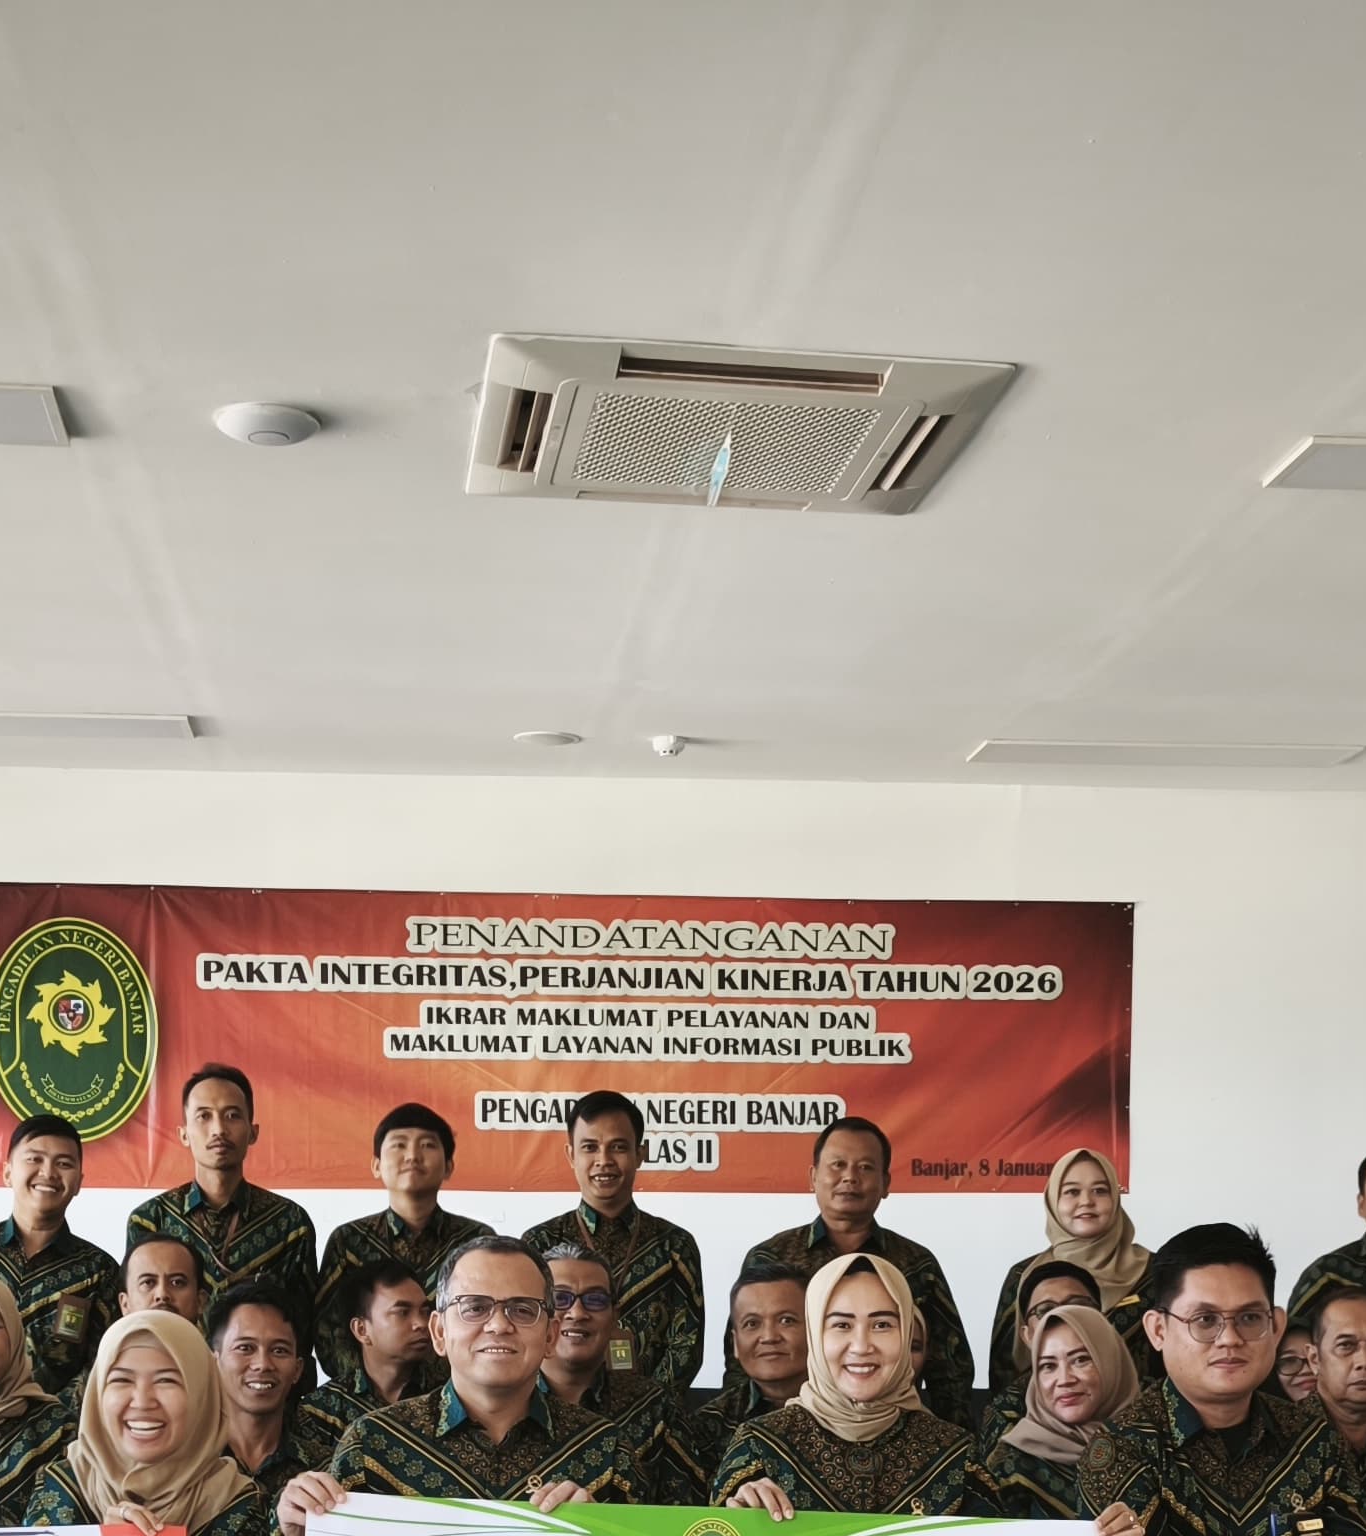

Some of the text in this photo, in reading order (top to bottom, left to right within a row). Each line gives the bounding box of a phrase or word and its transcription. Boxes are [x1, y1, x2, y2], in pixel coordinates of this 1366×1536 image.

[412, 922, 889, 953] PENANDATANGANAN
[59, 930, 121, 971] NEGERI
[117, 967, 144, 1035] BANJAR
[203, 959, 308, 985] PAKTA
[717, 967, 848, 993] KINERJA
[857, 969, 961, 994] TAHUN
[972, 970, 1057, 994] 2026
[426, 1006, 870, 1030] IKRAR MAKLUMAT PELAYANAN DAN
[390, 1034, 905, 1057] MAKLUMAT LAYANAN INFORMASI PUBLIK
[646, 1099, 736, 1125] NEGERI
[747, 1100, 839, 1125] BANJAR
[643, 1138, 713, 1164] LAS II
[911, 1158, 1056, 1181] Banjar, 8 Januar
